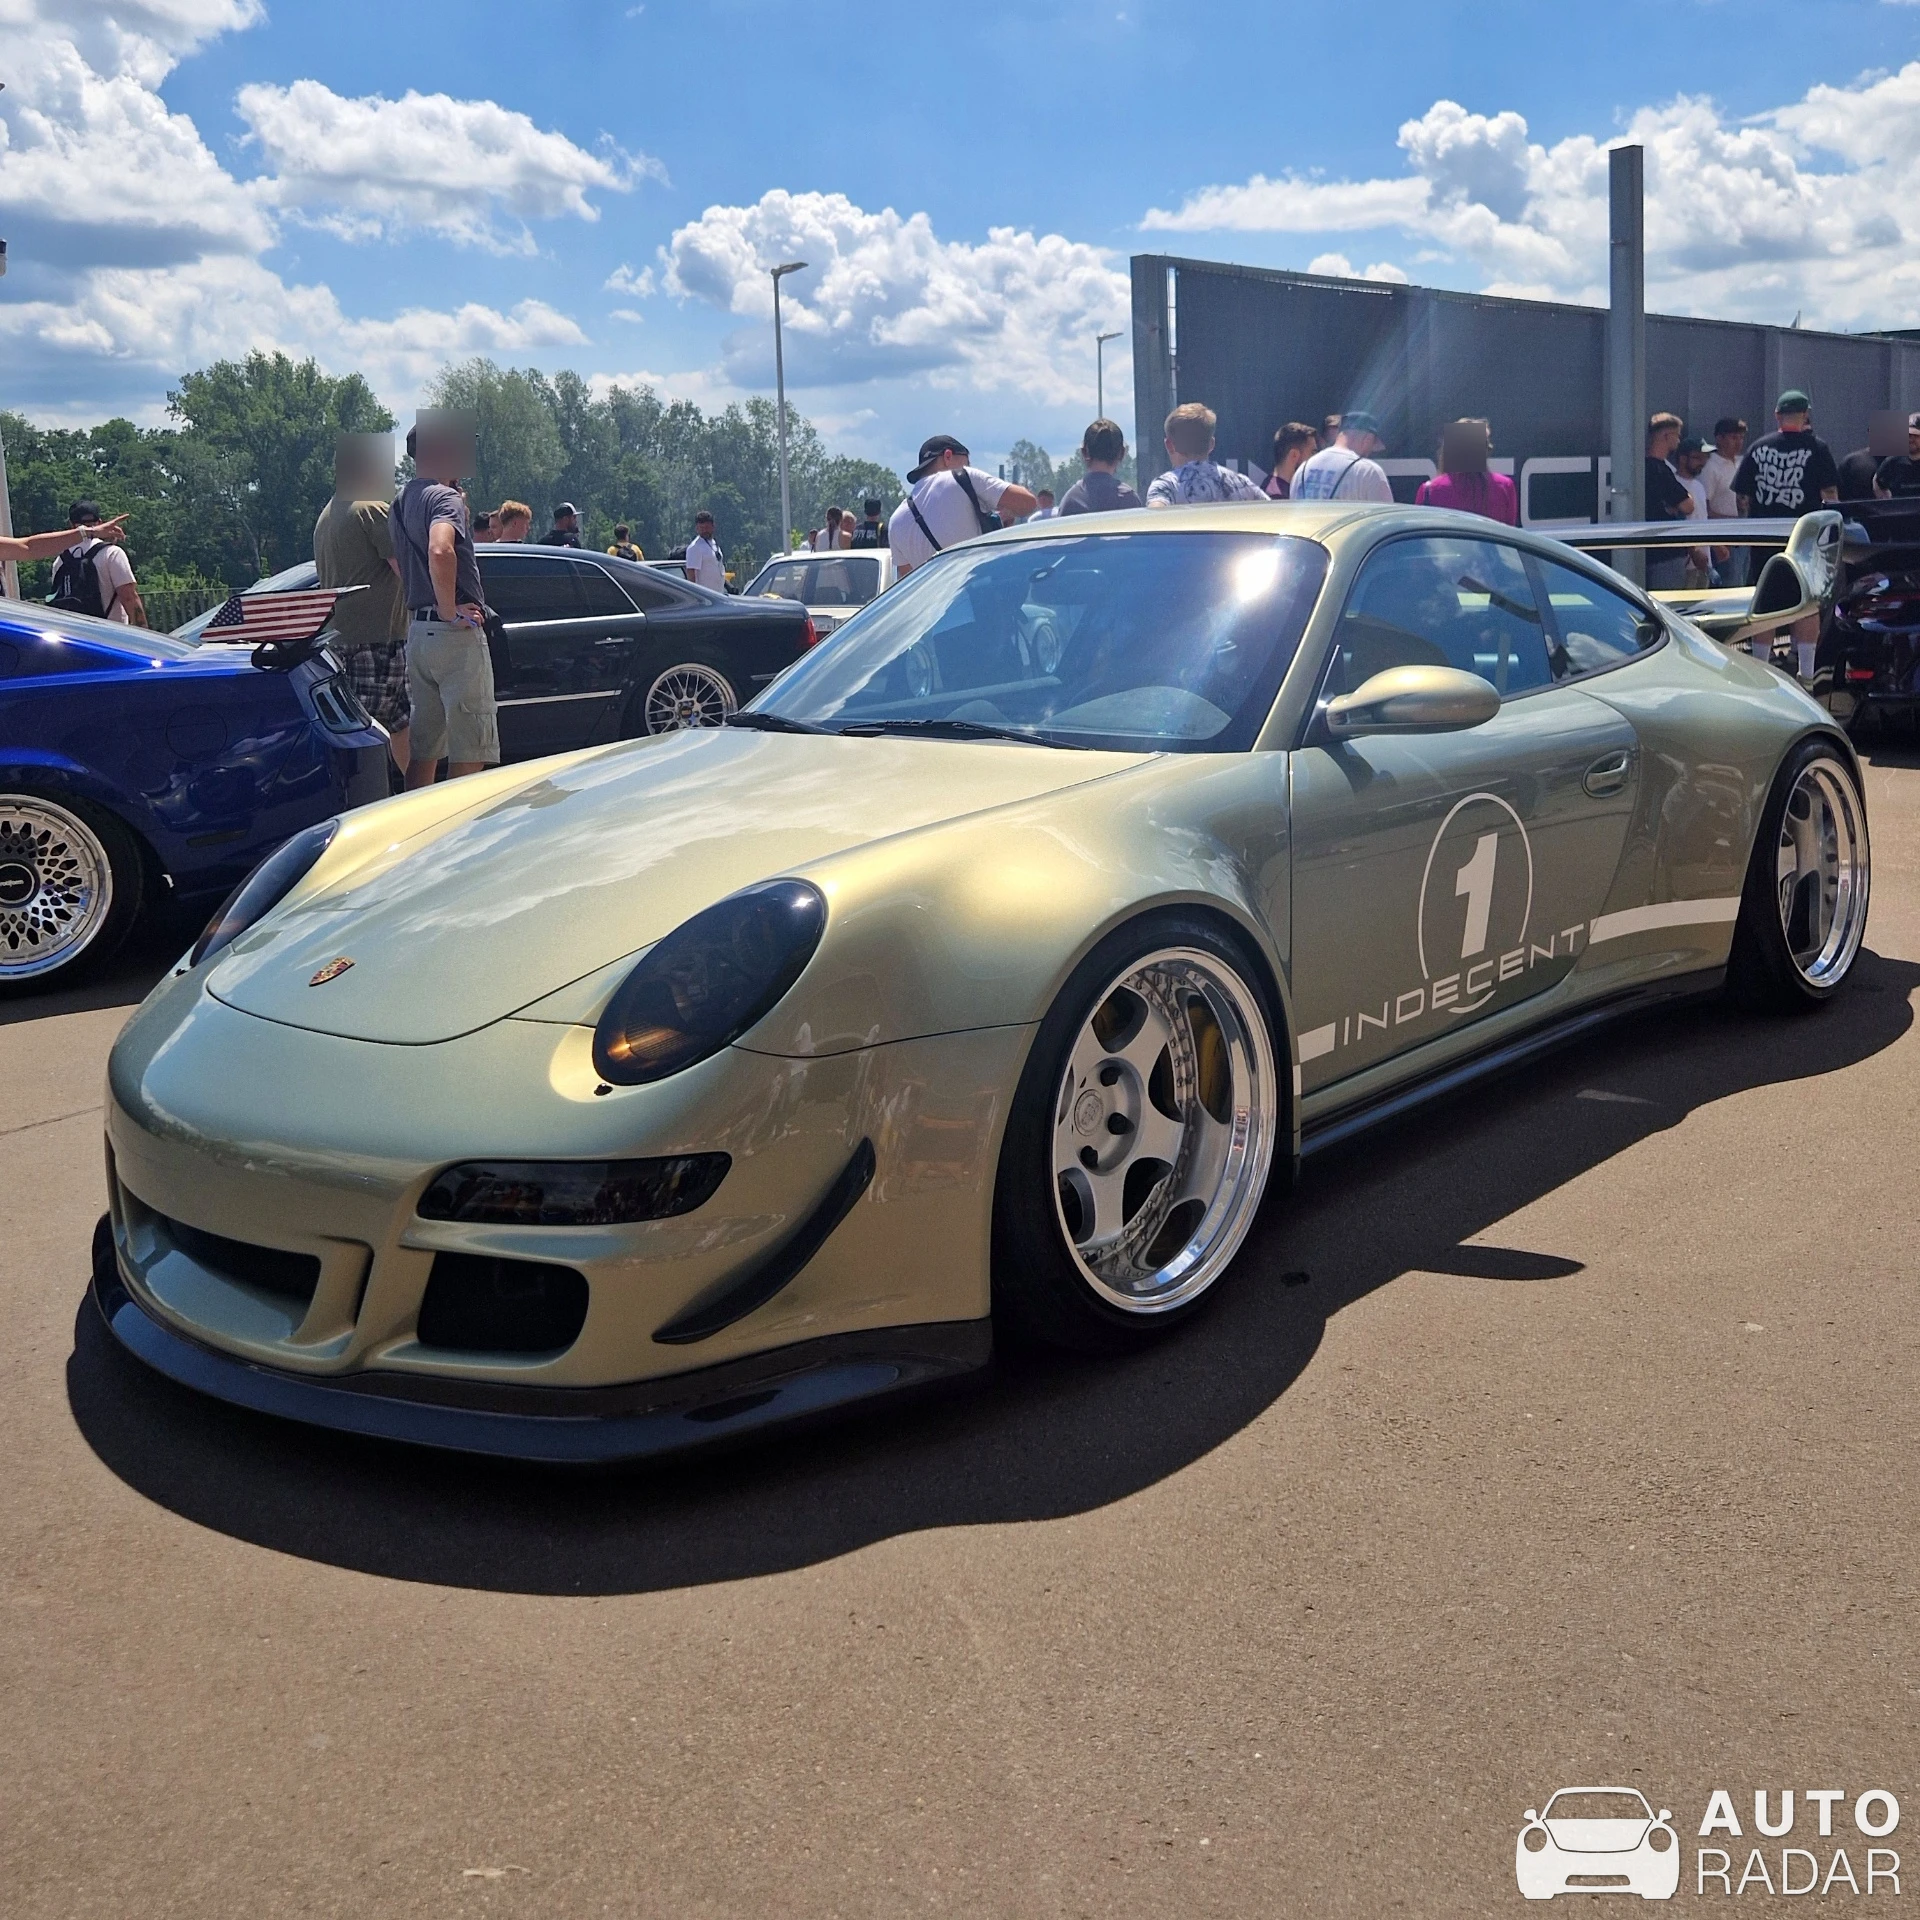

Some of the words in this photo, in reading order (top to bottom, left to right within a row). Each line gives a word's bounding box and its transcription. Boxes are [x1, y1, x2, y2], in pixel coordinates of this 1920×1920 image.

[1751, 445, 1812, 468] WATCH
[1755, 463, 1804, 488] YOUR
[1755, 482, 1804, 510] STEP
[1455, 832, 1498, 958] 1
[1343, 923, 1585, 1046] INDECENT
